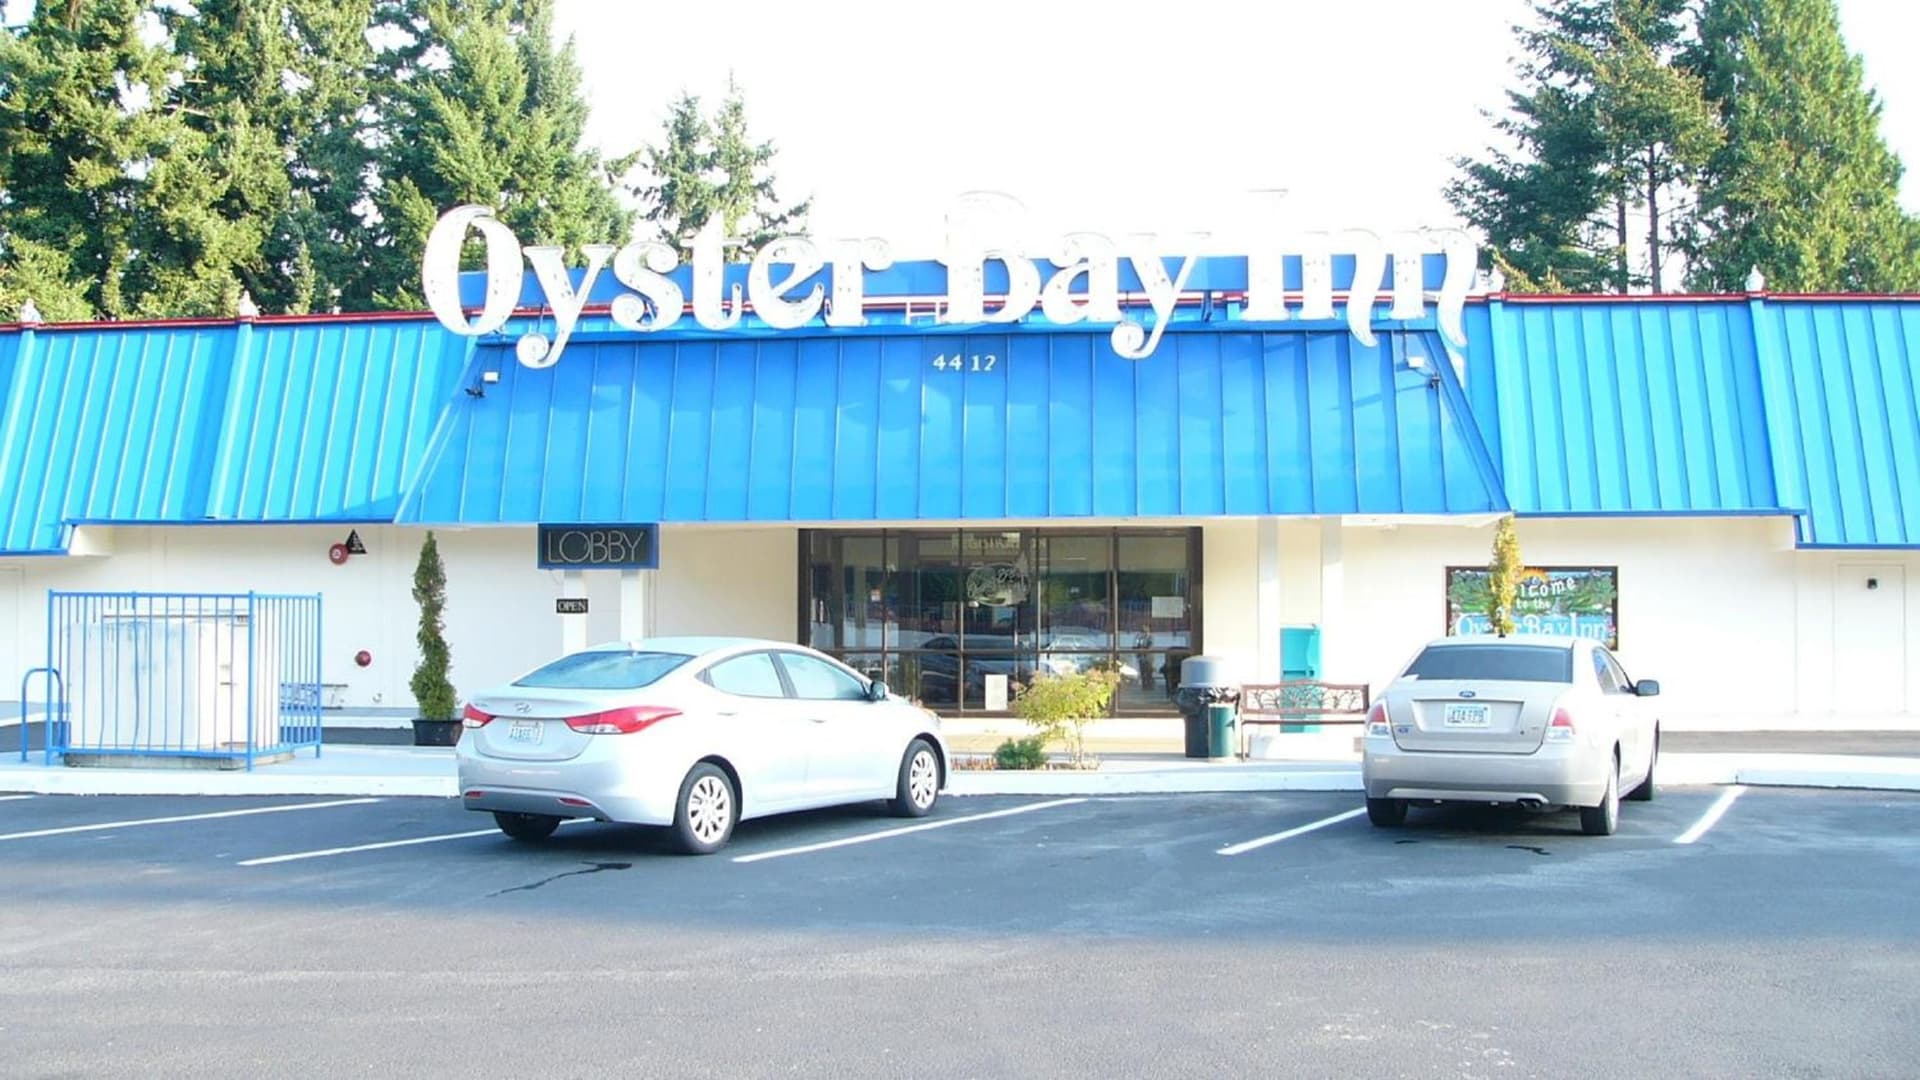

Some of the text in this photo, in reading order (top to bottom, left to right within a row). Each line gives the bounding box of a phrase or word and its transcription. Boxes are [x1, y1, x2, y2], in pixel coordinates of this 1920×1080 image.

[422, 189, 1478, 369] Oyster Bay Inn
[932, 353, 997, 371] 4412
[547, 530, 644, 563] LOBBY
[1513, 576, 1577, 598] lcome
[557, 600, 587, 612] OPEN
